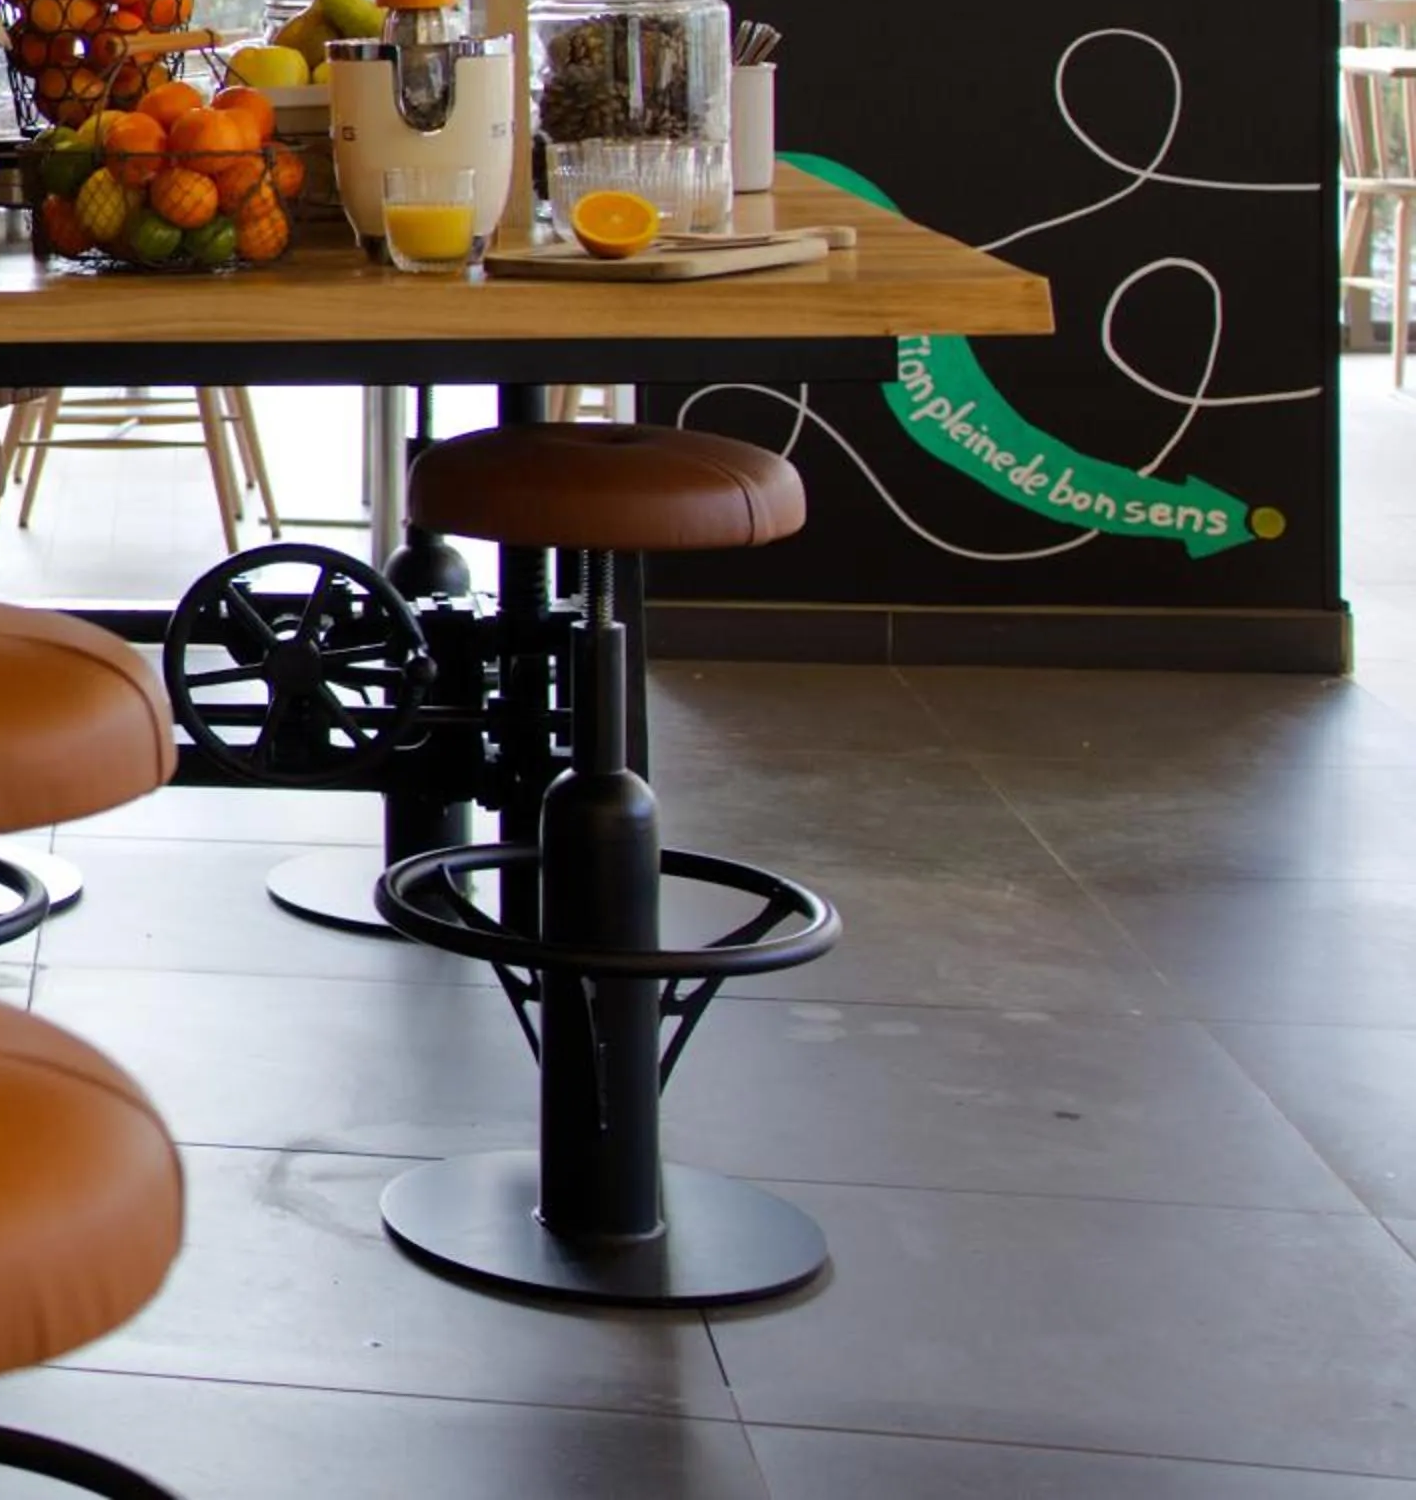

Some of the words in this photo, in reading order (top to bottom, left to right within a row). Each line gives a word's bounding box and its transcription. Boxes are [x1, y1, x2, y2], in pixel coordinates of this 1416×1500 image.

[908, 396, 1018, 473] pleine
[1007, 453, 1050, 496] de
[1047, 467, 1117, 521] bon
[1123, 500, 1228, 536] sens
